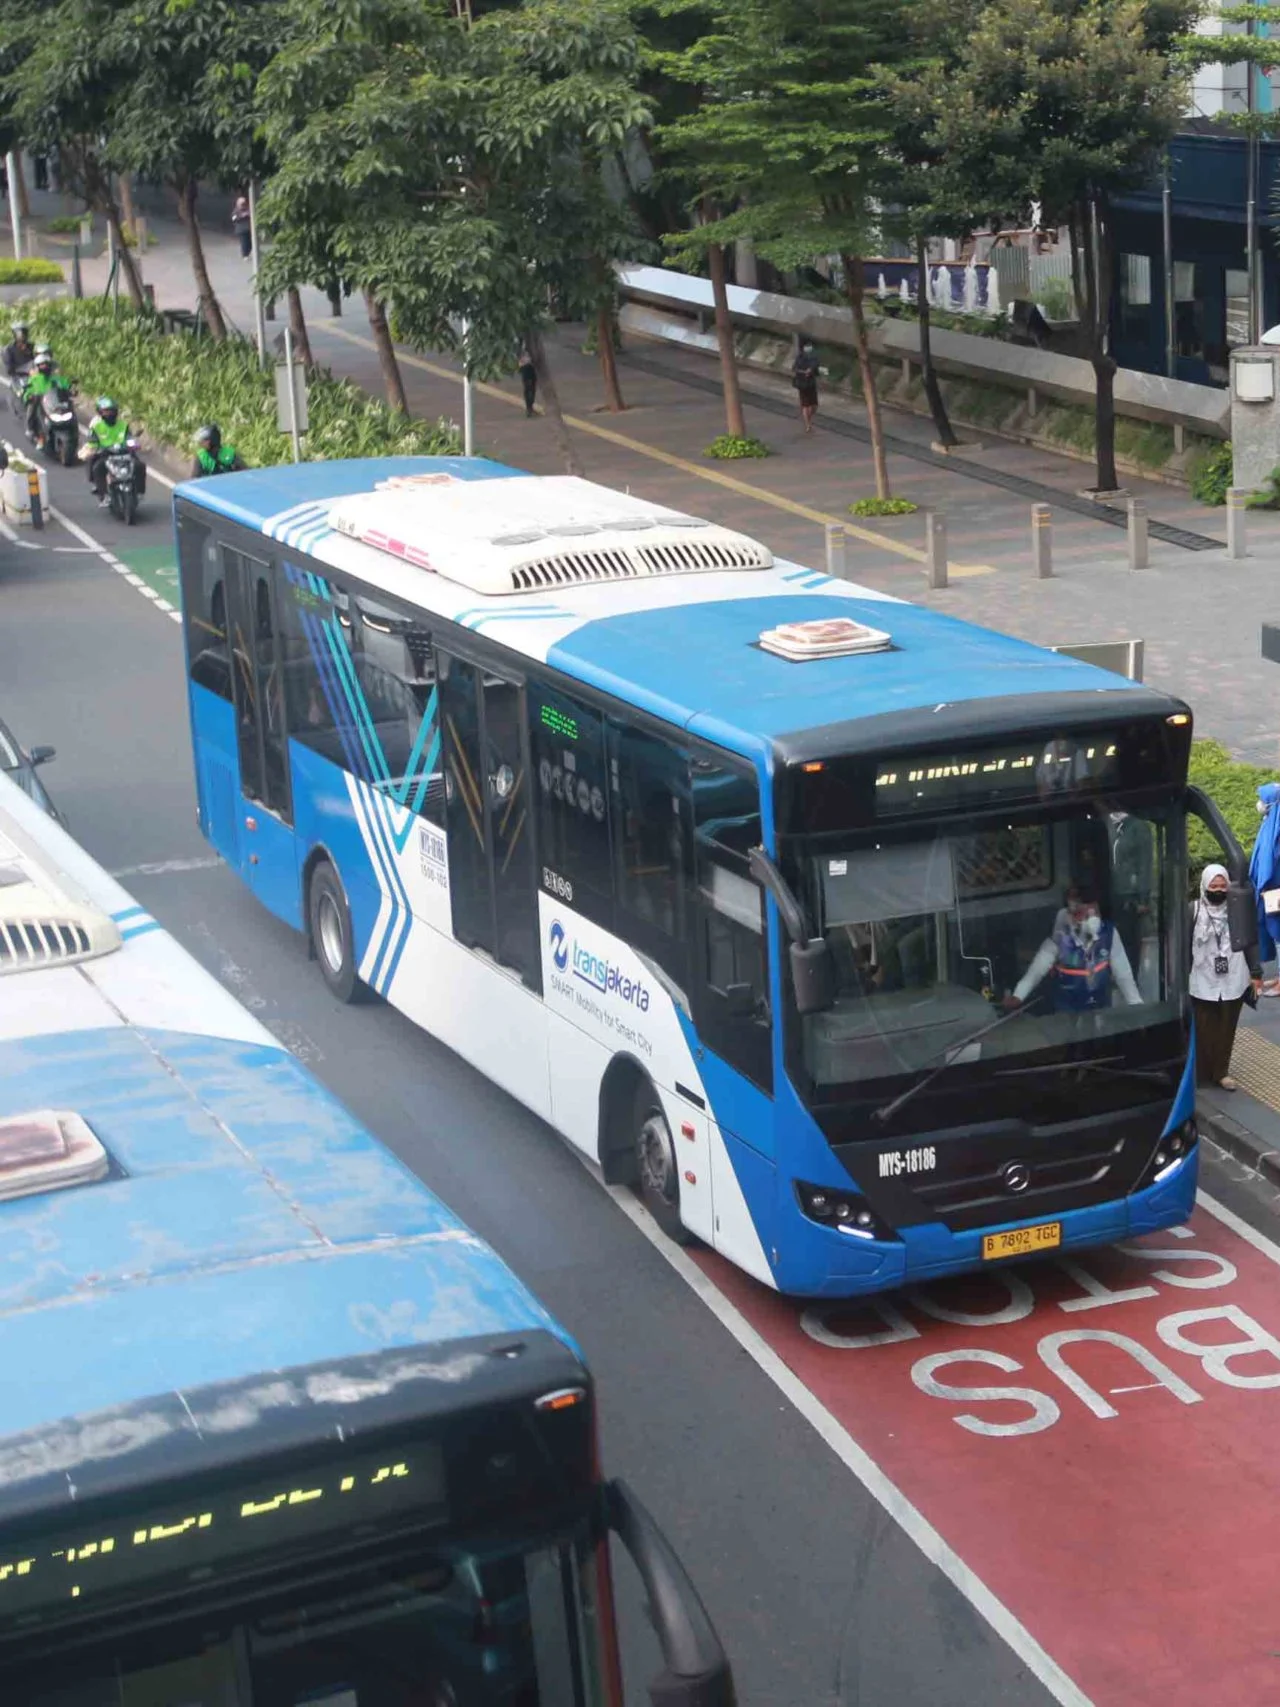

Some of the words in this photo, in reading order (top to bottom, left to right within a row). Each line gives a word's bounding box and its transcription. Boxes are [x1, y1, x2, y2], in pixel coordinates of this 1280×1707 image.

[572, 938, 650, 1012] transjakarta
[878, 1146, 937, 1178] MYS-18186
[986, 1239, 994, 1252] B
[1036, 1224, 1058, 1242] TGC
